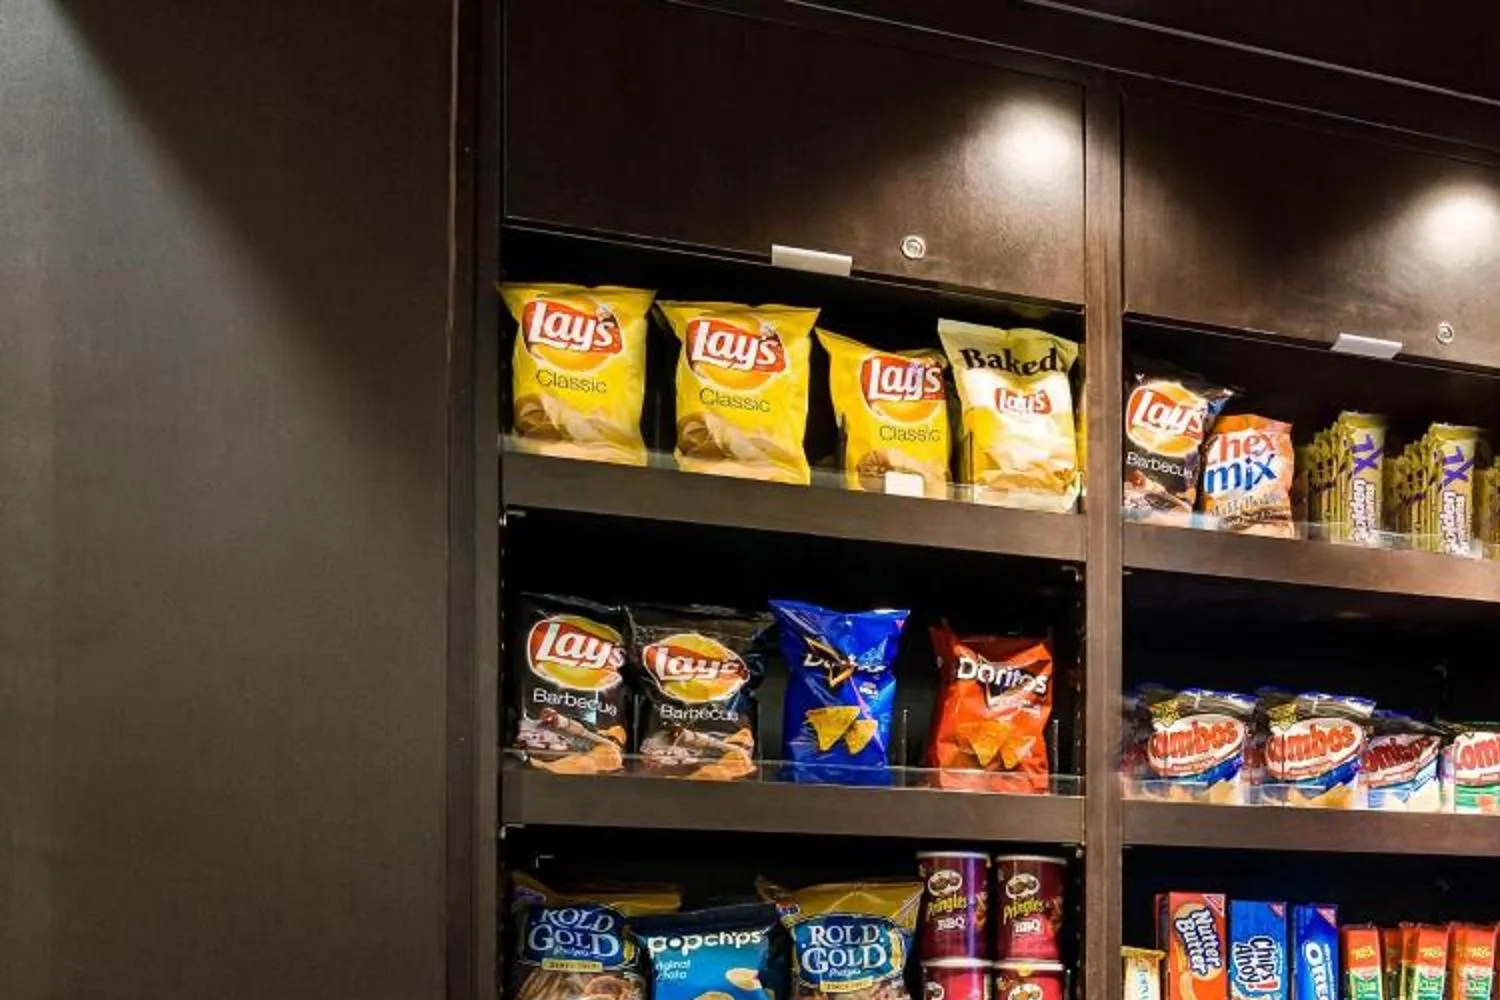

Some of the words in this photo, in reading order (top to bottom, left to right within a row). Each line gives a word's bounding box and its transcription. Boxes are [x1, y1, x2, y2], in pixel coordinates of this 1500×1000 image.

[529, 299, 615, 353] Lay's
[691, 320, 778, 370] Lay's
[960, 348, 1057, 377] Baked
[535, 368, 608, 394] Classic
[868, 358, 943, 401] Lay's
[699, 387, 771, 413] Classic
[878, 424, 941, 443] Classic
[1126, 451, 1193, 477] Barbecue
[1206, 452, 1278, 494] mix
[957, 656, 1049, 695] Doritos
[533, 687, 618, 717] Barbecue
[660, 703, 739, 722] Barbecue
[530, 923, 620, 957] GOLD
[647, 931, 761, 959] popchips
[807, 924, 881, 948] ROLD
[1175, 917, 1209, 977] Butter
[1191, 908, 1223, 968] Nutter
[801, 942, 888, 974] GOLD
